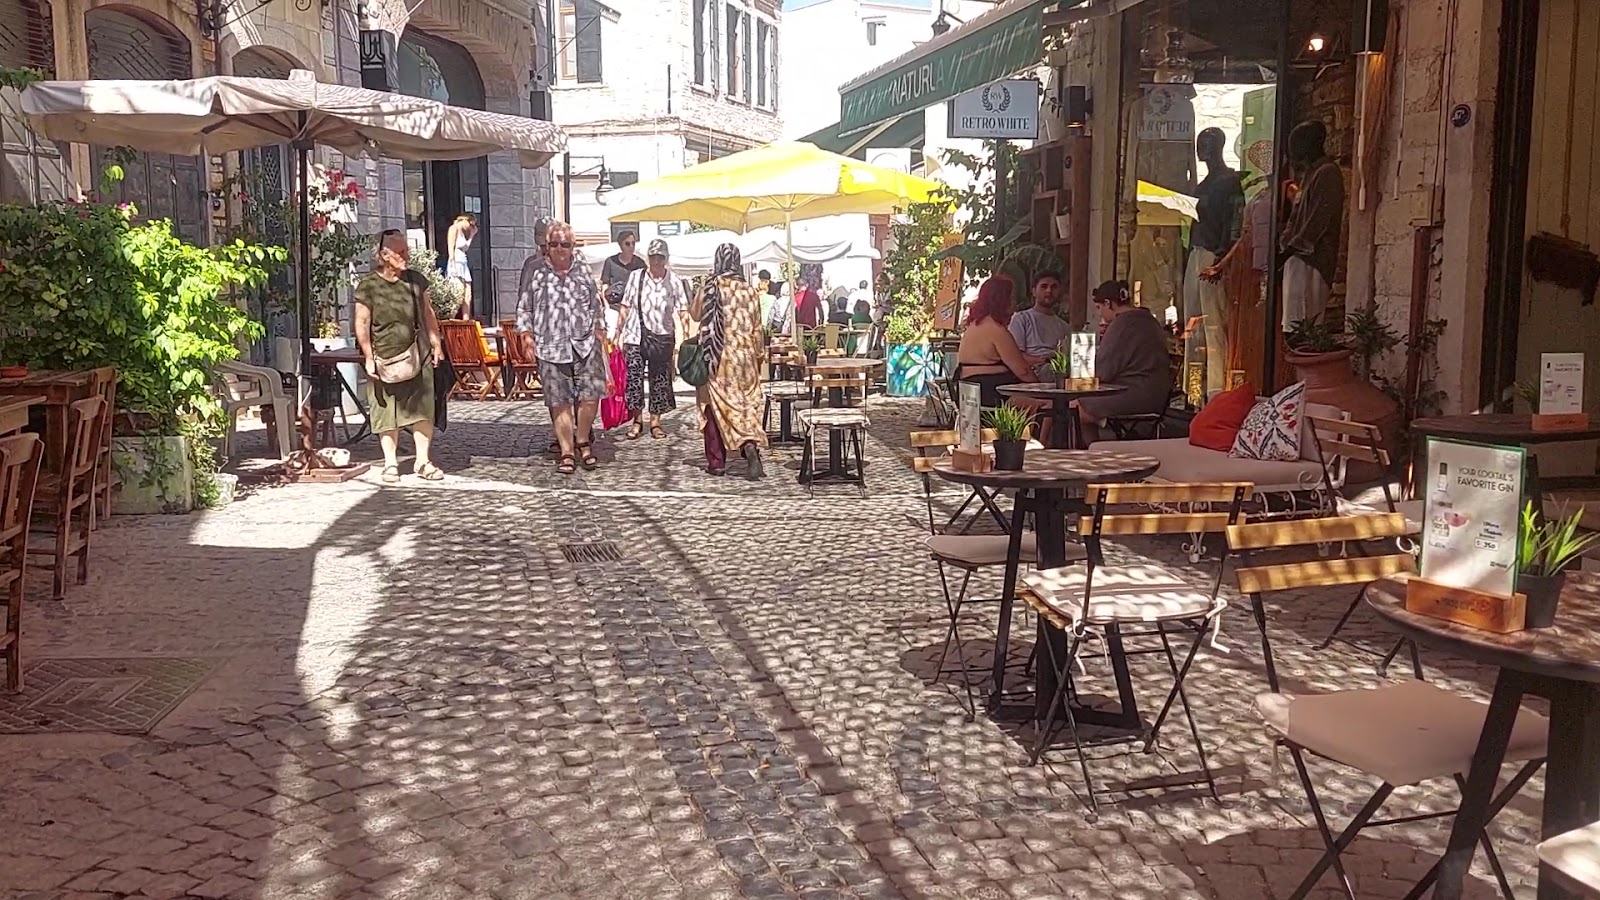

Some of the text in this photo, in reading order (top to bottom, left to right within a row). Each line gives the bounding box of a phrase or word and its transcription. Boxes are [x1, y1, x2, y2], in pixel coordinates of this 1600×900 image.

[962, 117, 1030, 130] RETRO WHITE
[1459, 467, 1476, 476] YOUR
[1457, 476, 1514, 493] FAVORITE GIN
